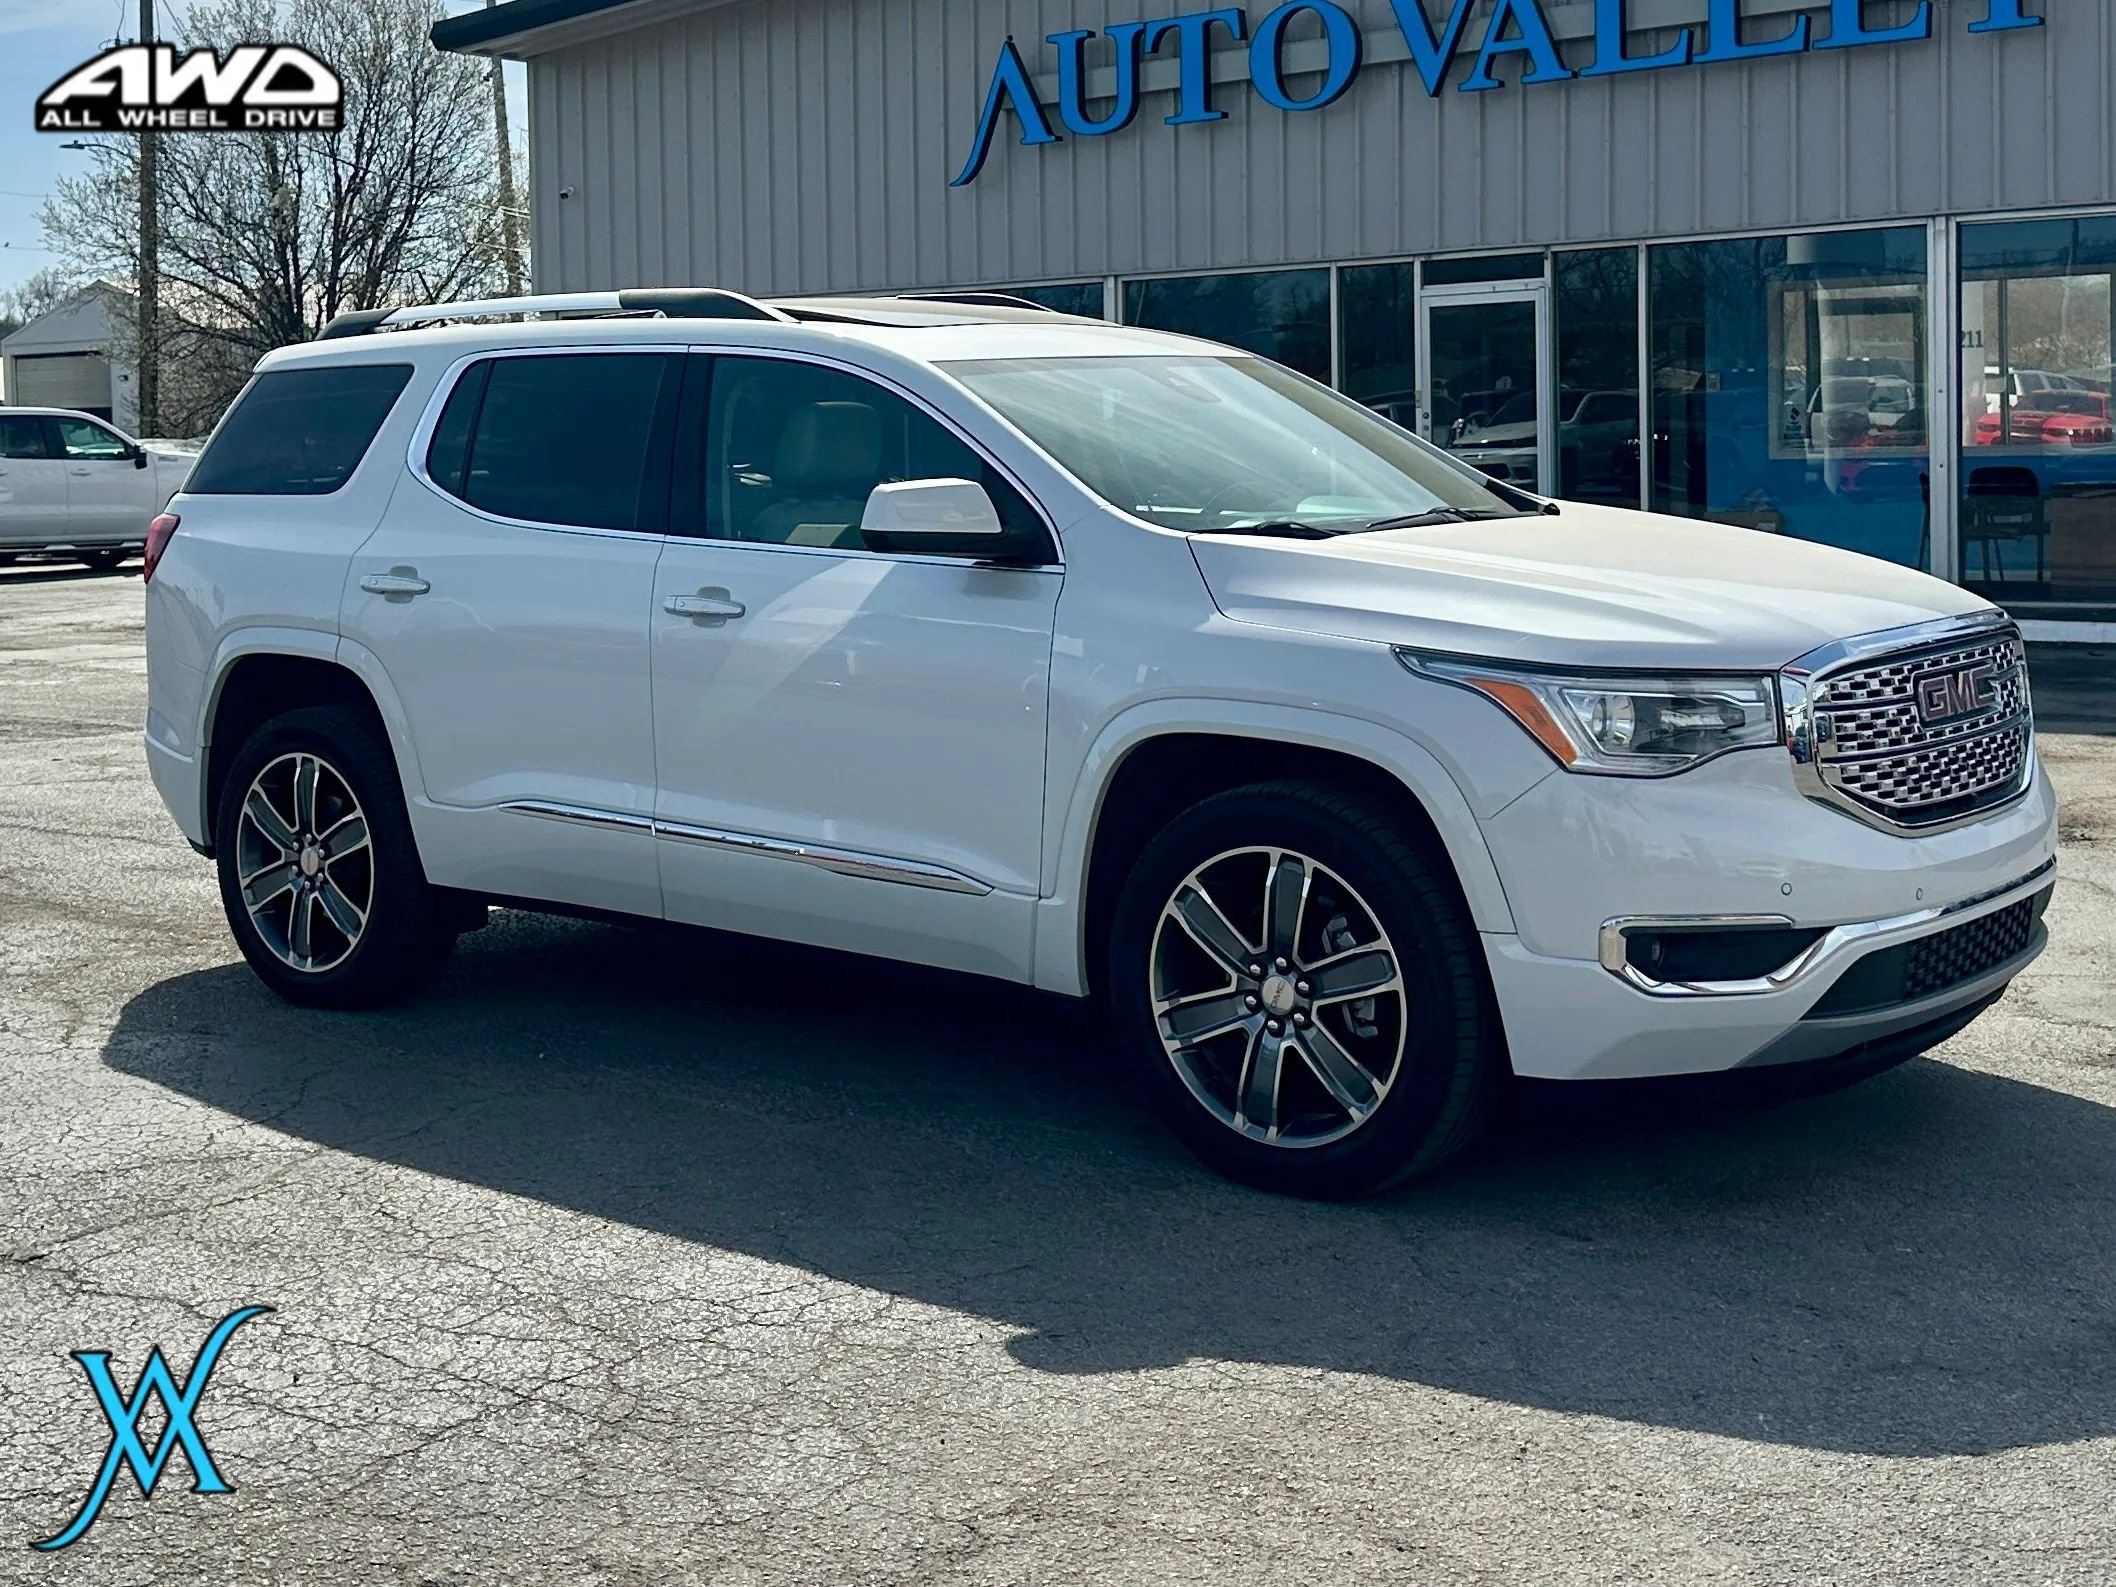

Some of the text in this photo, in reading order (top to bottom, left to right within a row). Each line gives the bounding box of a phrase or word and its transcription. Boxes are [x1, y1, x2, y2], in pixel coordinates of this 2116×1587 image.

[949, 0, 2045, 187] AUTO VALL
[1918, 664, 1995, 721] GMC
